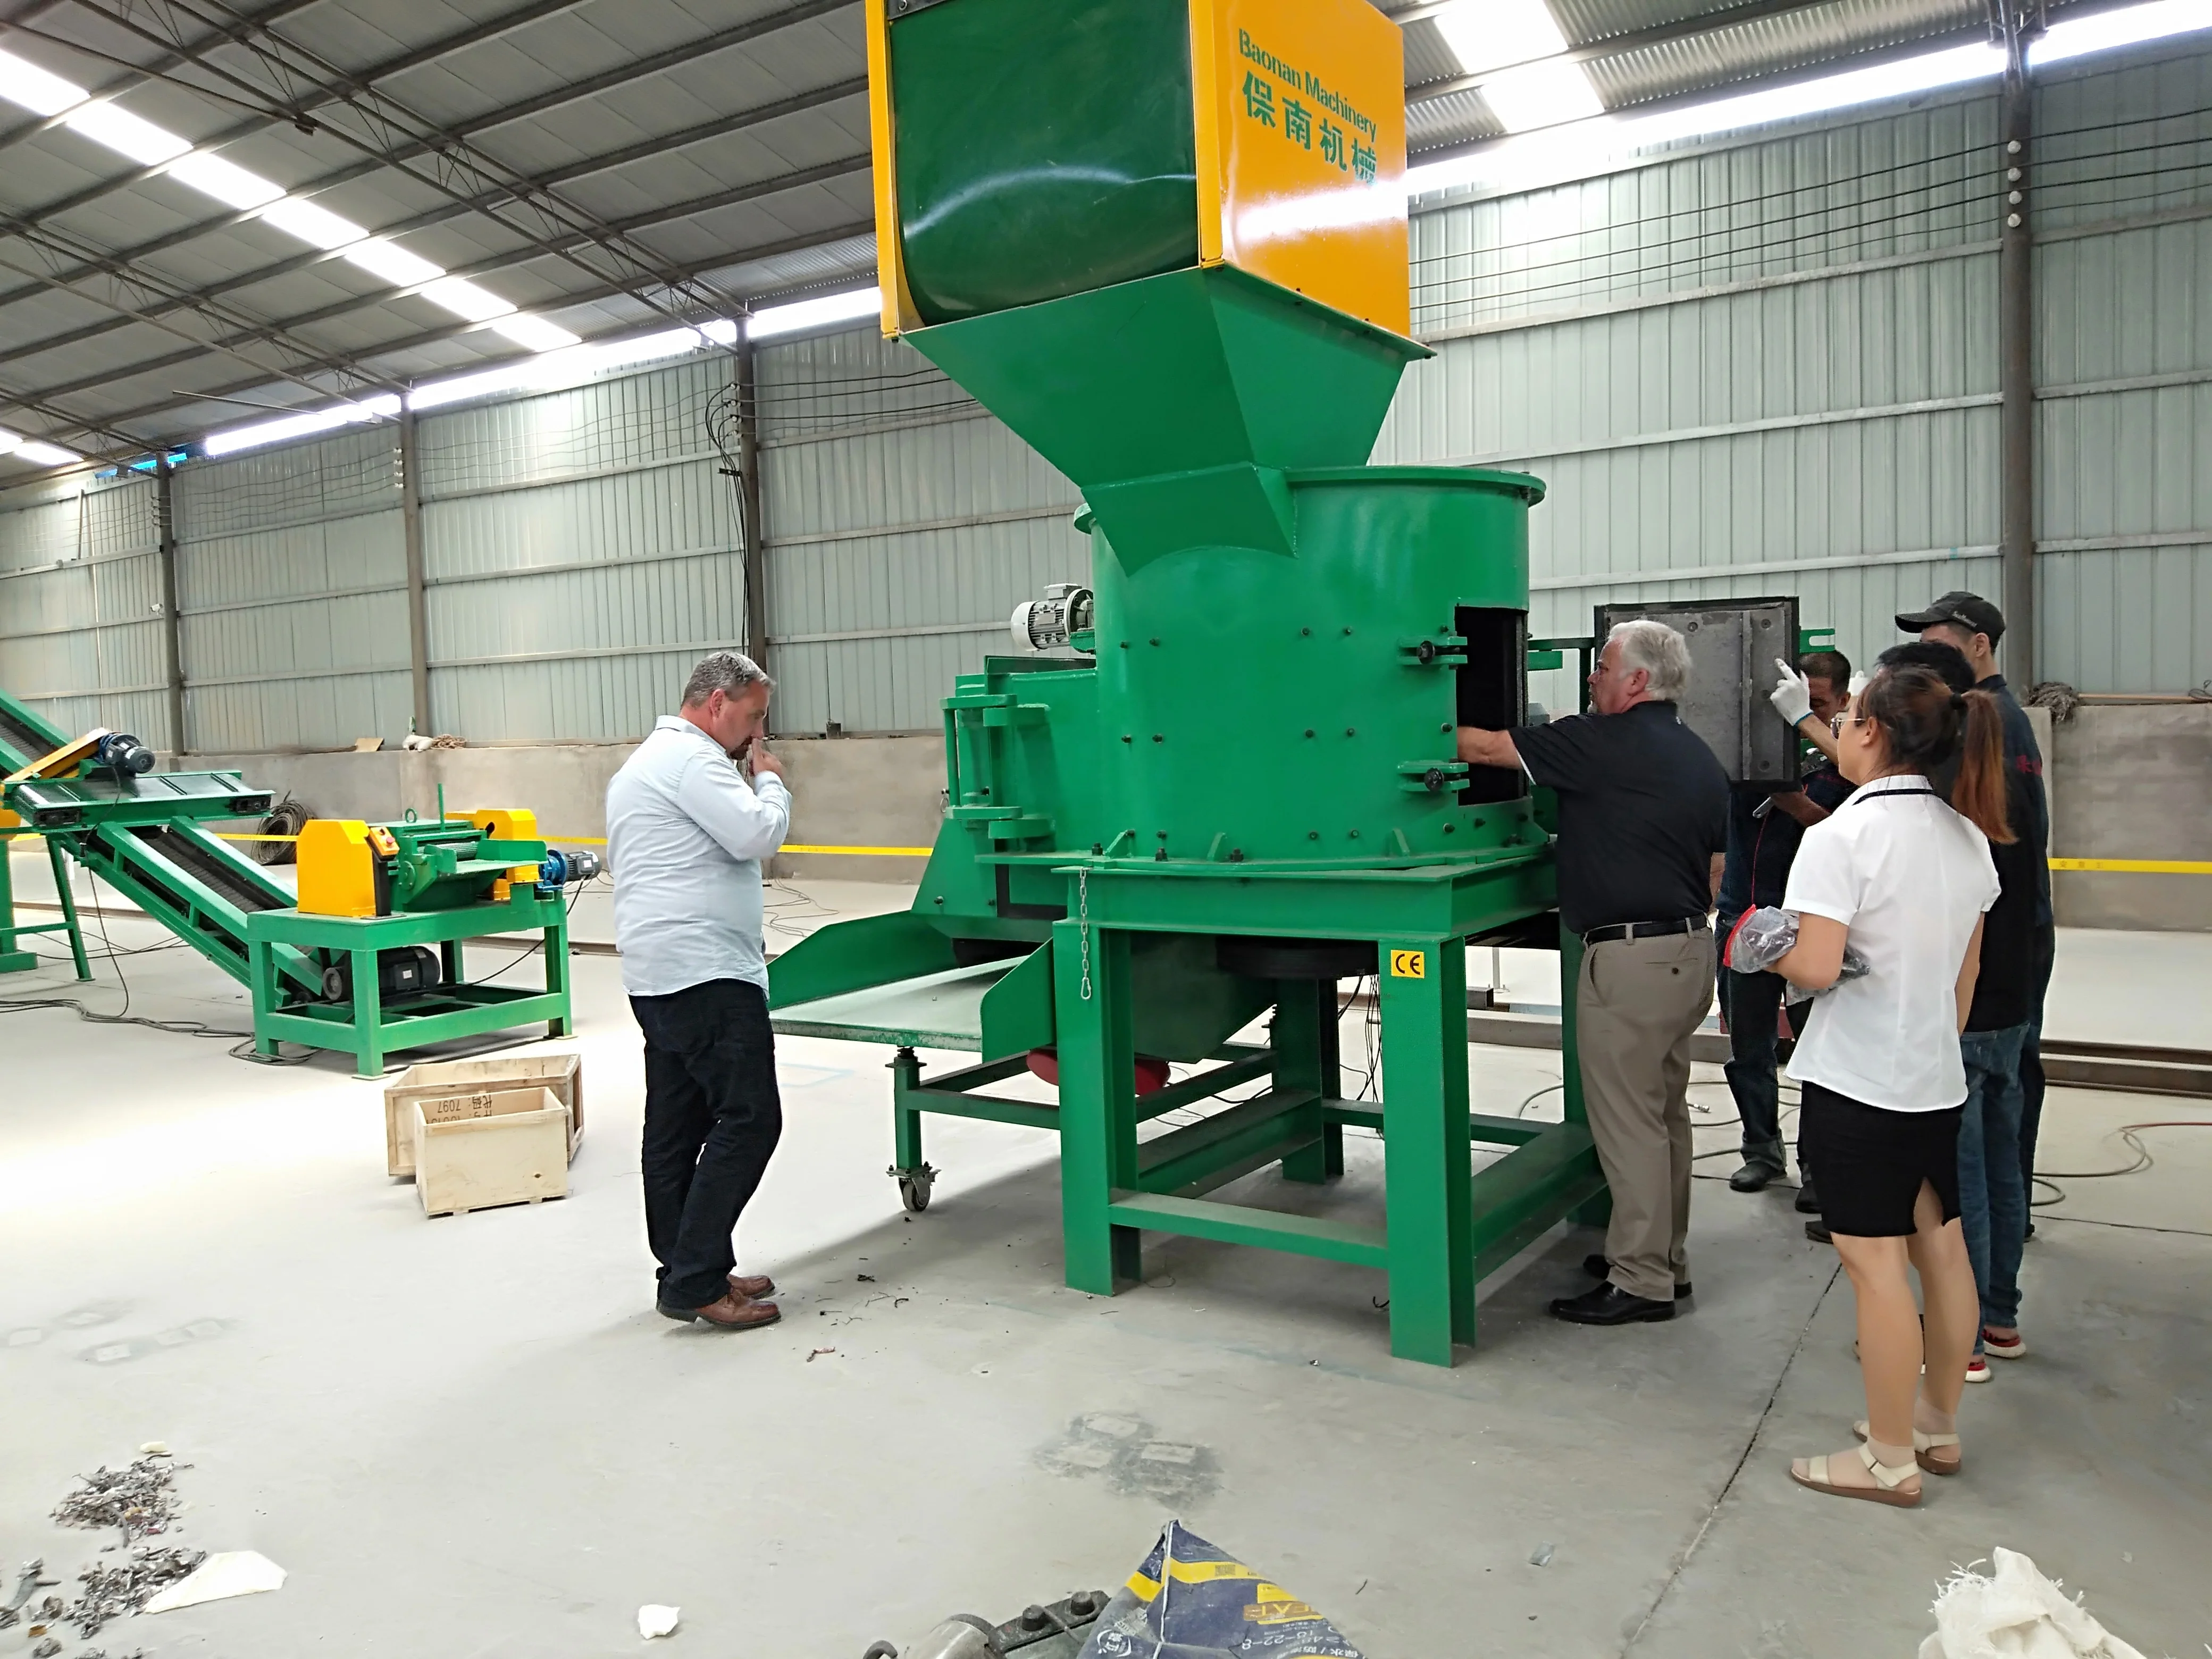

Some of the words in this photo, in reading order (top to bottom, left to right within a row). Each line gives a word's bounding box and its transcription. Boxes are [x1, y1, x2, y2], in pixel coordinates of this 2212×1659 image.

[1239, 28, 1301, 90] Baonan
[1305, 71, 1376, 143] Machinery
[1242, 70, 1377, 186] 保南机械
[1395, 953, 1420, 975] CE
[437, 1099, 461, 1113] 7097
